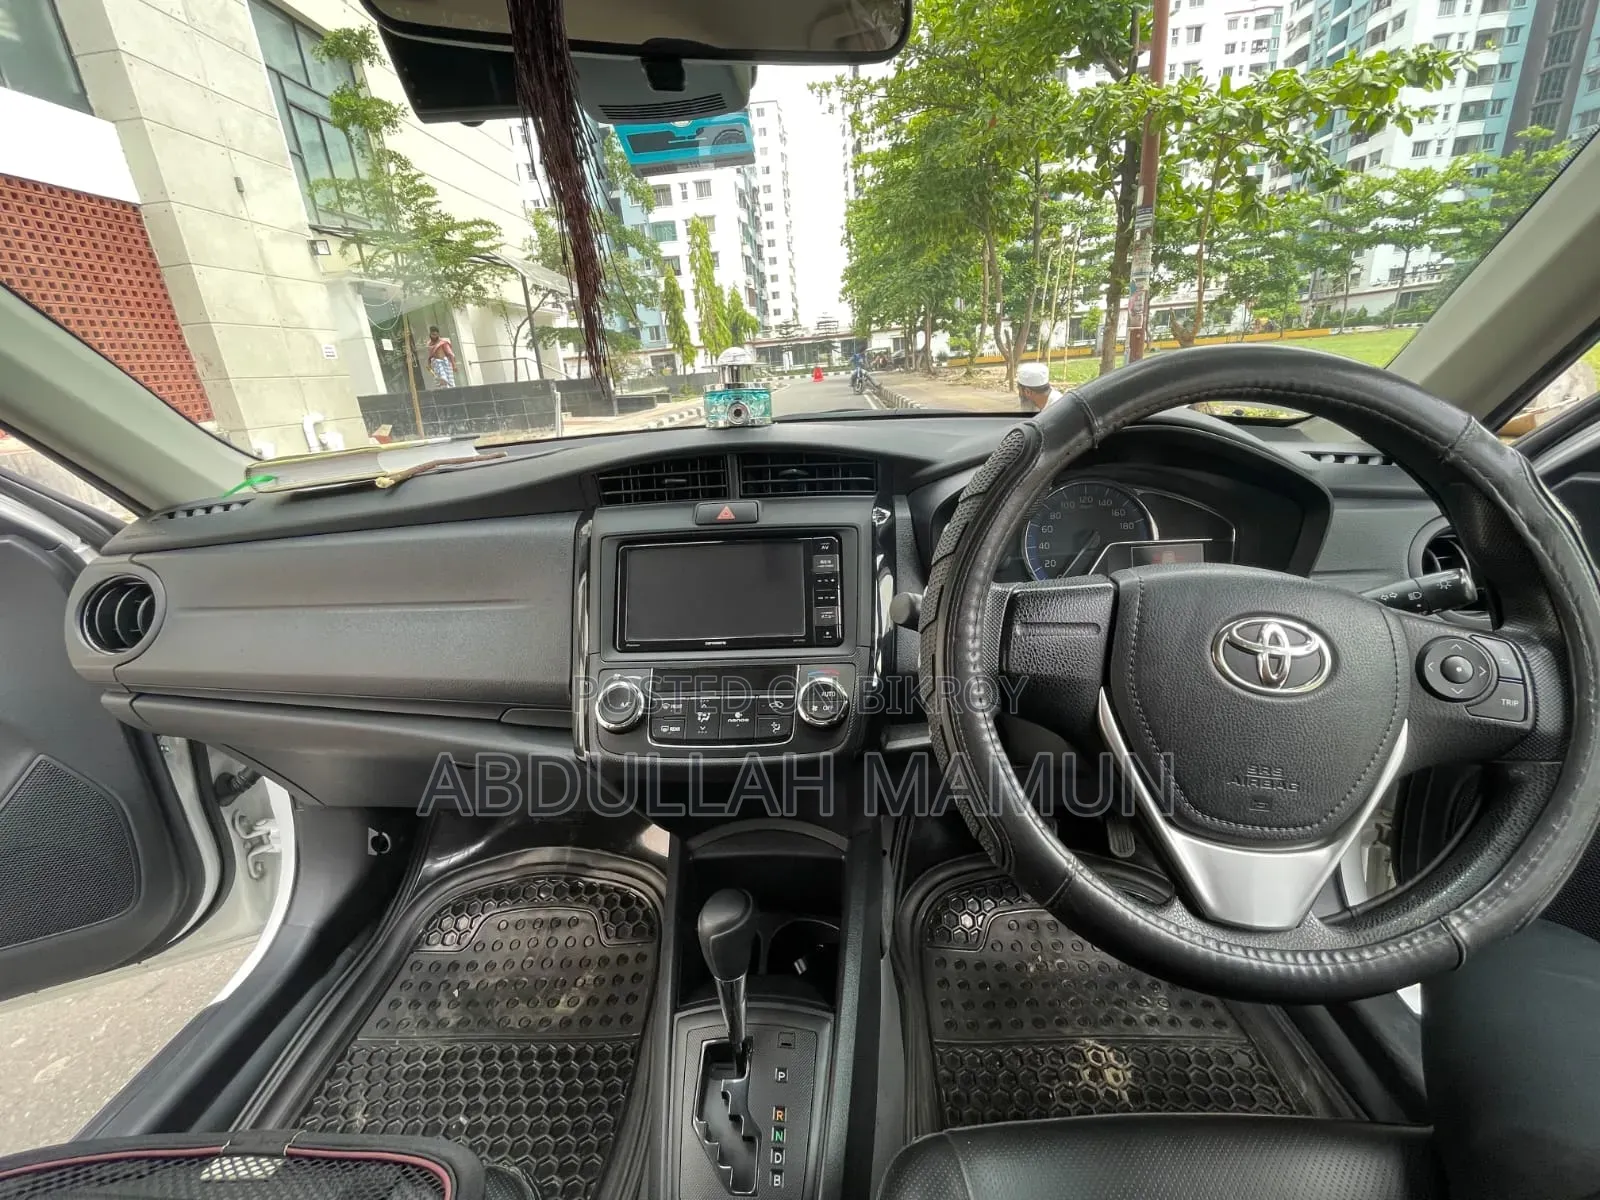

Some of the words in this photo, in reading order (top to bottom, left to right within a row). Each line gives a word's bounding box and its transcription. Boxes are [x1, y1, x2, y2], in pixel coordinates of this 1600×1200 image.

[1079, 496, 1094, 504] 120
[1060, 501, 1075, 509] 100
[1049, 511, 1062, 520] 80
[1111, 509, 1126, 517] 160
[1041, 525, 1054, 533] 60
[1119, 522, 1135, 530] 180
[1038, 542, 1050, 550] 40
[1044, 560, 1057, 568] 20
[1501, 698, 1519, 707] TRIP
[778, 1071, 786, 1081] P
[776, 1110, 784, 1121] R
[775, 1131, 784, 1141] N
[774, 1152, 782, 1163] D
[773, 1174, 781, 1186] B
